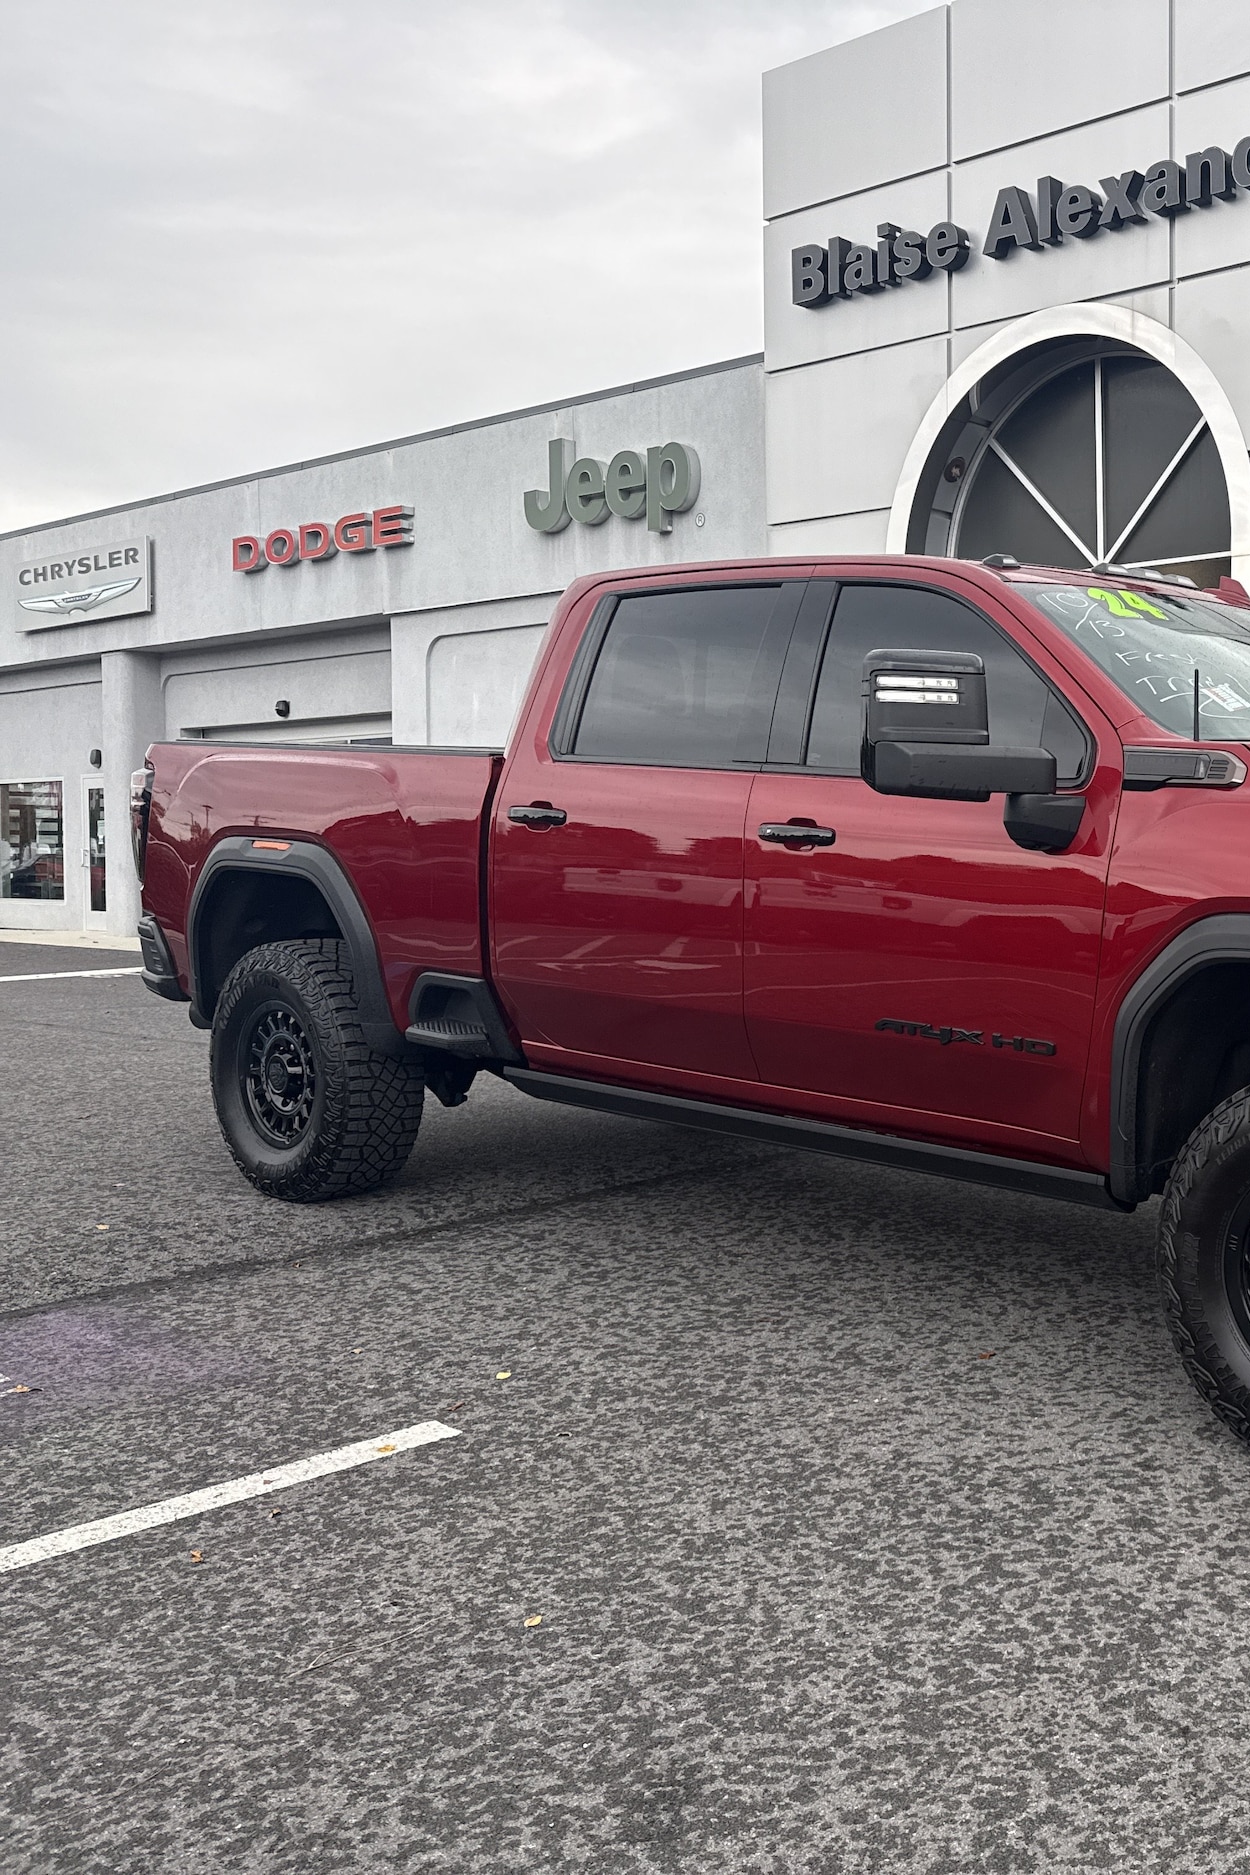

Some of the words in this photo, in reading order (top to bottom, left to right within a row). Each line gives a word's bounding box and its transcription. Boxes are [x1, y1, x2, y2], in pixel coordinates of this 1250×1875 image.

[791, 221, 970, 308] Blaise
[523, 437, 701, 533] Jeep
[232, 504, 415, 572] DODGE
[18, 547, 140, 586] CHRYSLER
[1087, 588, 1169, 620] 24
[874, 1017, 985, 1046] AT4X
[992, 1032, 1057, 1057] HD
